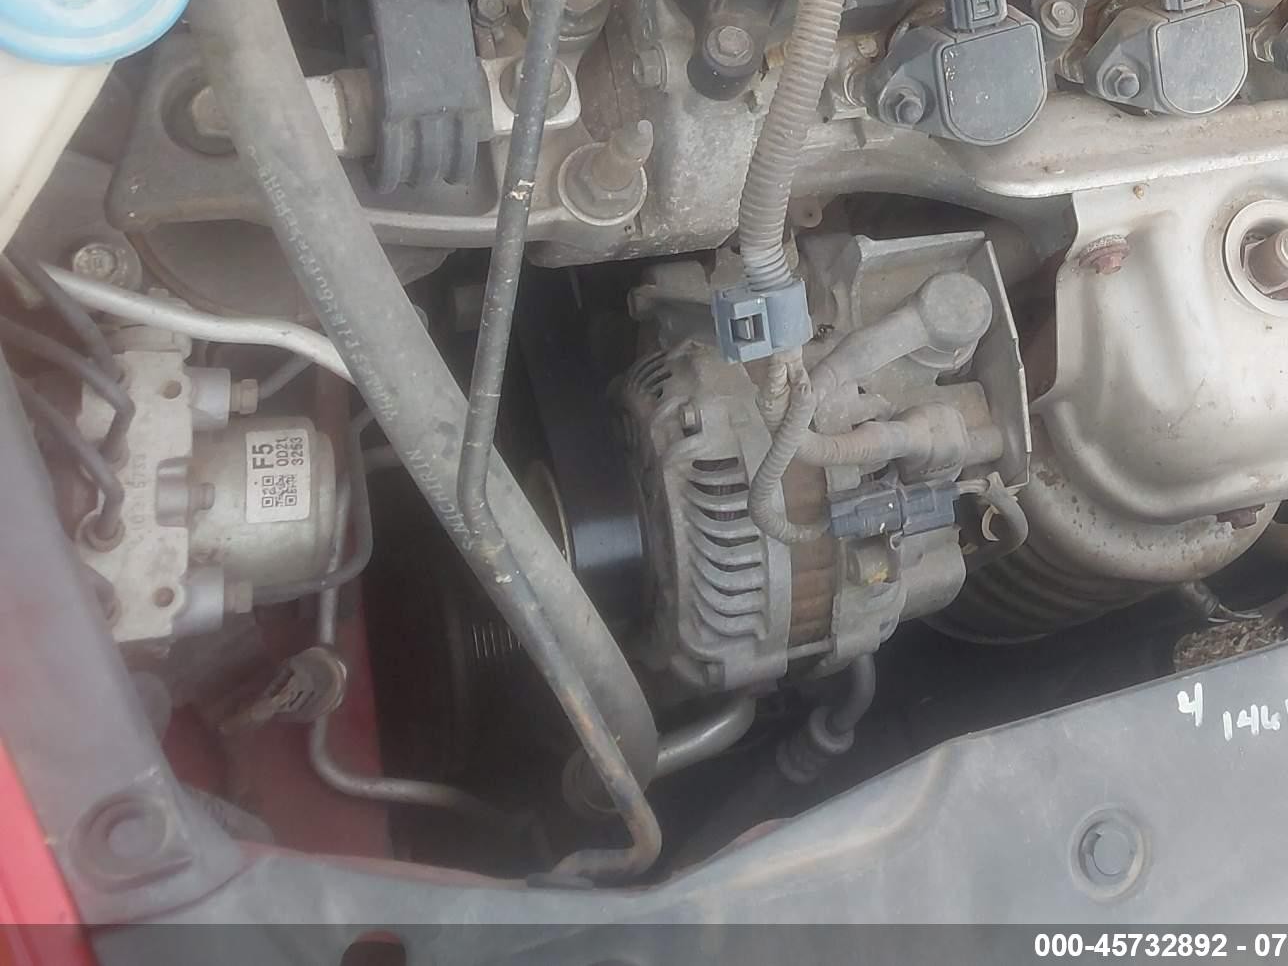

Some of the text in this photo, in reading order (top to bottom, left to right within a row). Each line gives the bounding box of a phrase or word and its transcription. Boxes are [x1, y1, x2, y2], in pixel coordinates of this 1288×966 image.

[251, 443, 275, 470] F5
[289, 436, 305, 466] 3253
[405, 448, 473, 535] NICHIRIN
[1176, 682, 1203, 727] 4
